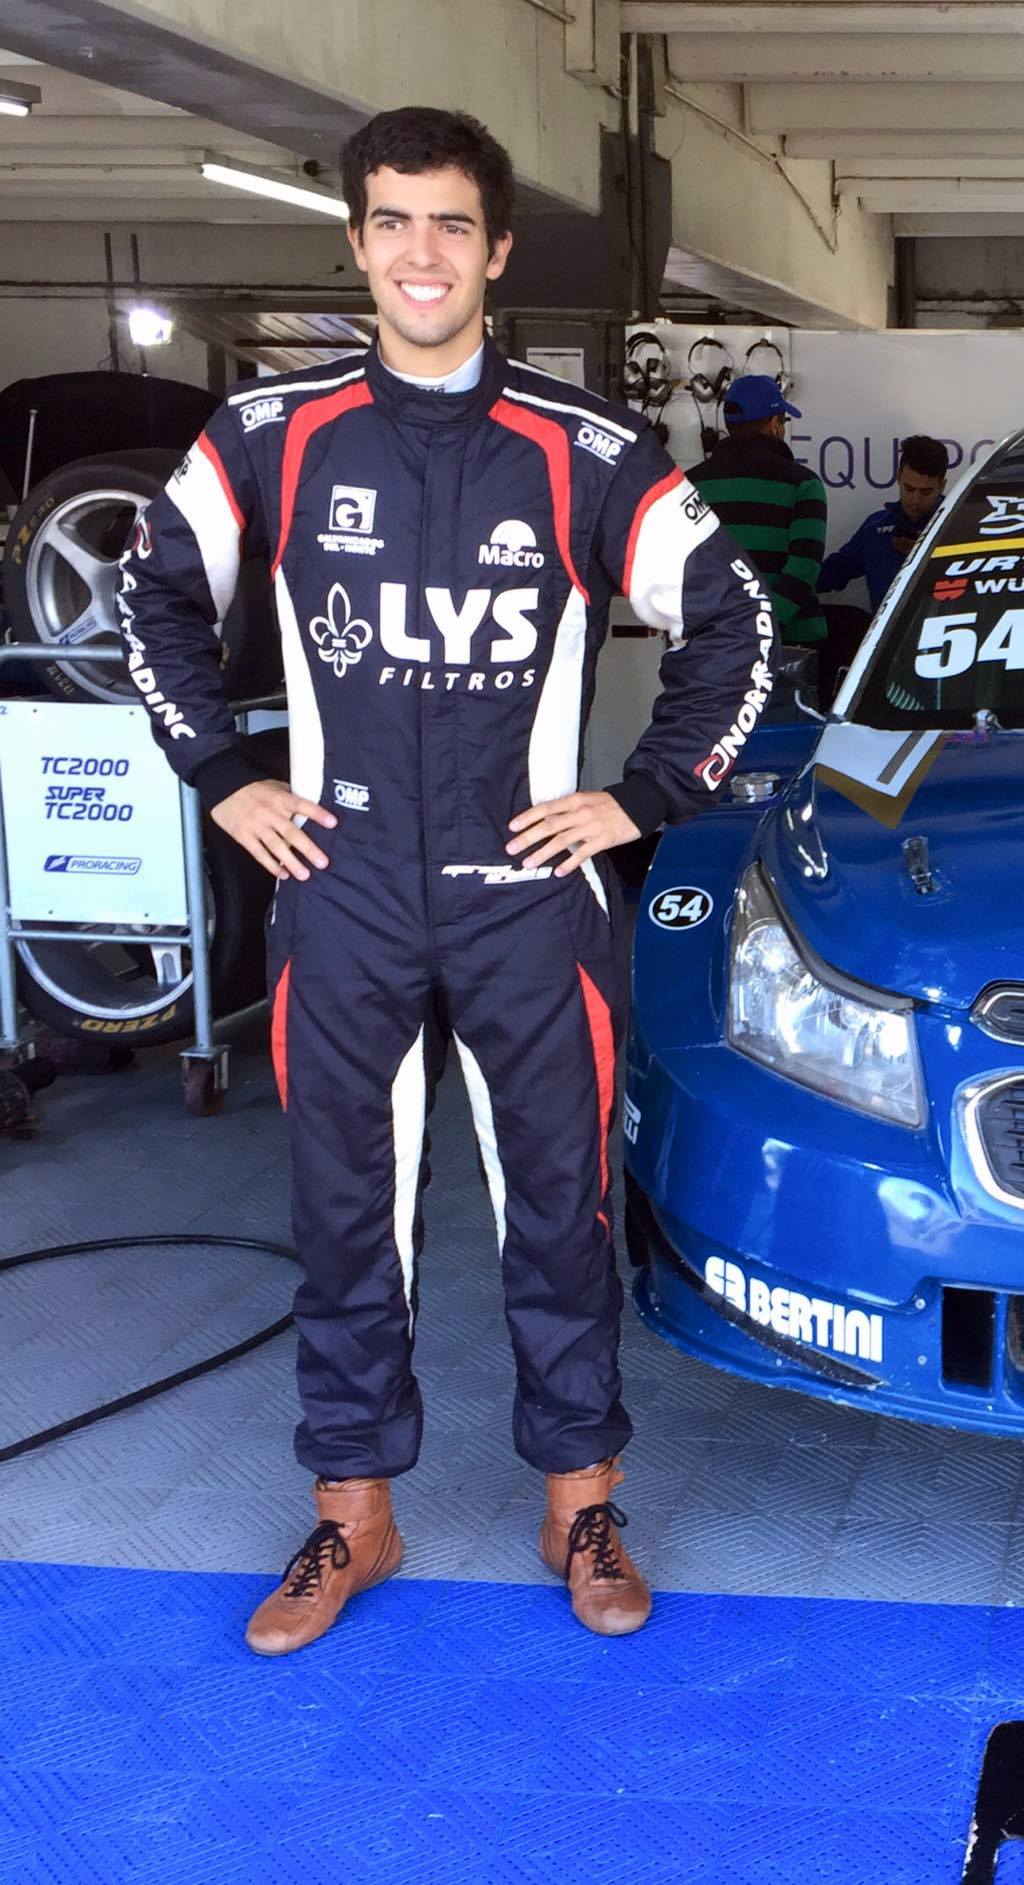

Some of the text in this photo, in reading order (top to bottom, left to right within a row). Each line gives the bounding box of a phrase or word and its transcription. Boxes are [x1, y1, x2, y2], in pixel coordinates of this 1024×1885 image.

[241, 400, 284, 427] OMP
[577, 426, 622, 459] OMP
[477, 543, 545, 568] Macro
[379, 581, 540, 665] LYS
[378, 666, 537, 691] FILTROS
[41, 757, 130, 777] TC2000
[45, 786, 106, 801] SUPER
[334, 785, 370, 807] OMP
[45, 803, 134, 822] TC2000
[70, 860, 138, 872] PRORACING
[656, 895, 703, 923] 54
[750, 1278, 883, 1363] BERTINI
